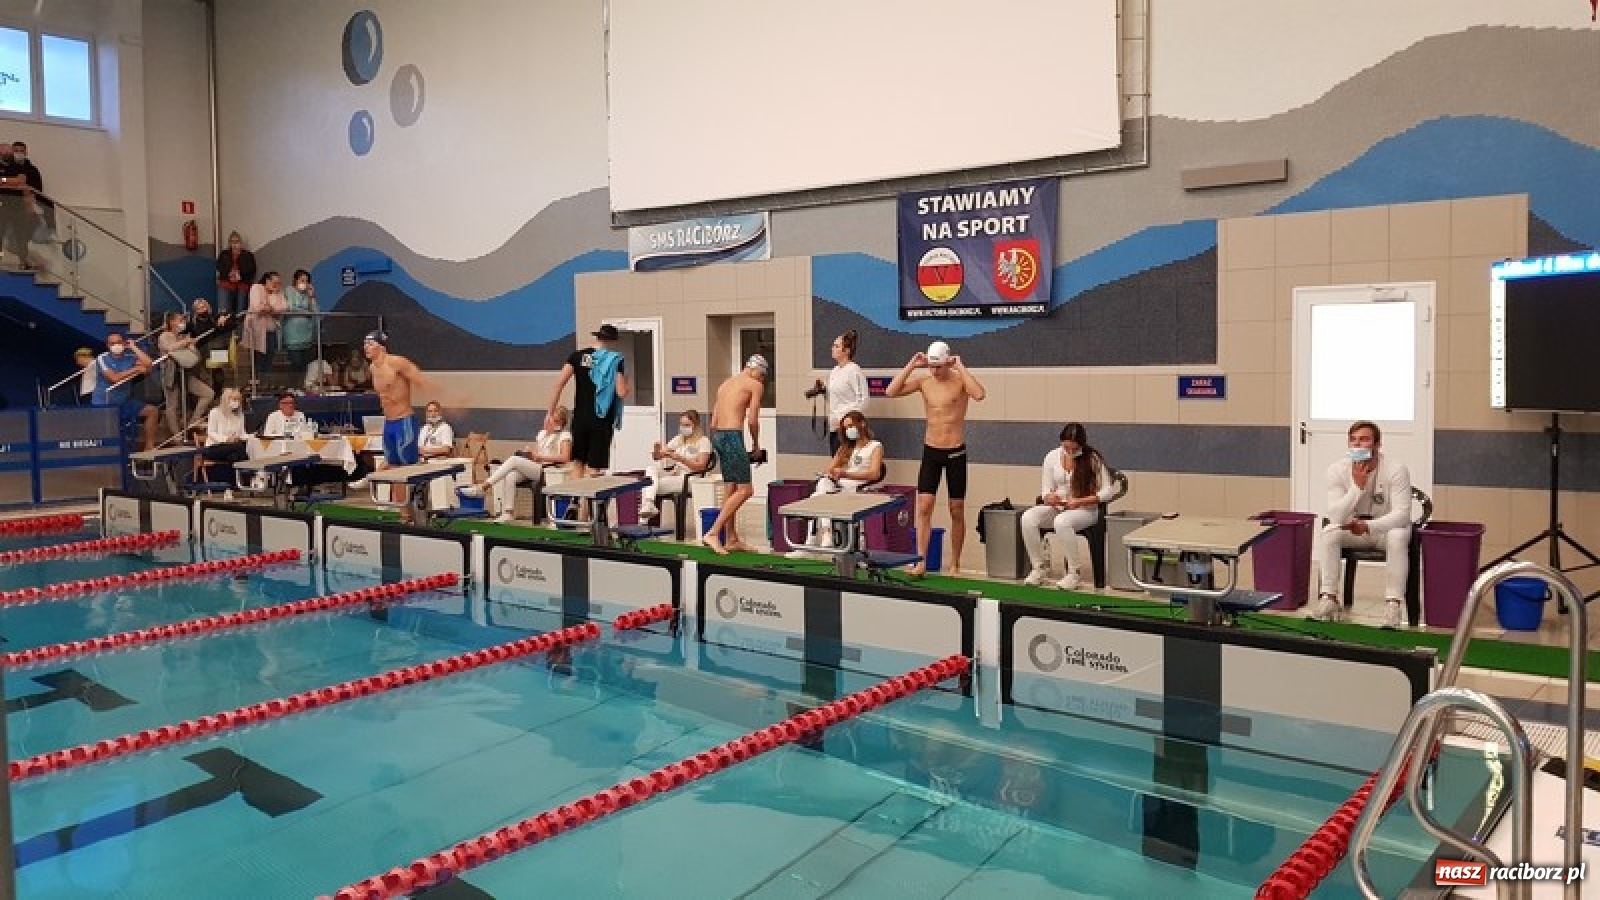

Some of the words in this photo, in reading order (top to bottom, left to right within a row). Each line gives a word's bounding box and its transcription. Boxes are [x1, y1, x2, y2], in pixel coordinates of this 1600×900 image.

[917, 186, 1035, 215] STAWIAMY
[649, 229, 675, 249] SMS
[923, 222, 953, 241] NA
[957, 214, 1031, 238] SPORT
[1064, 646, 1121, 663] Colorado
